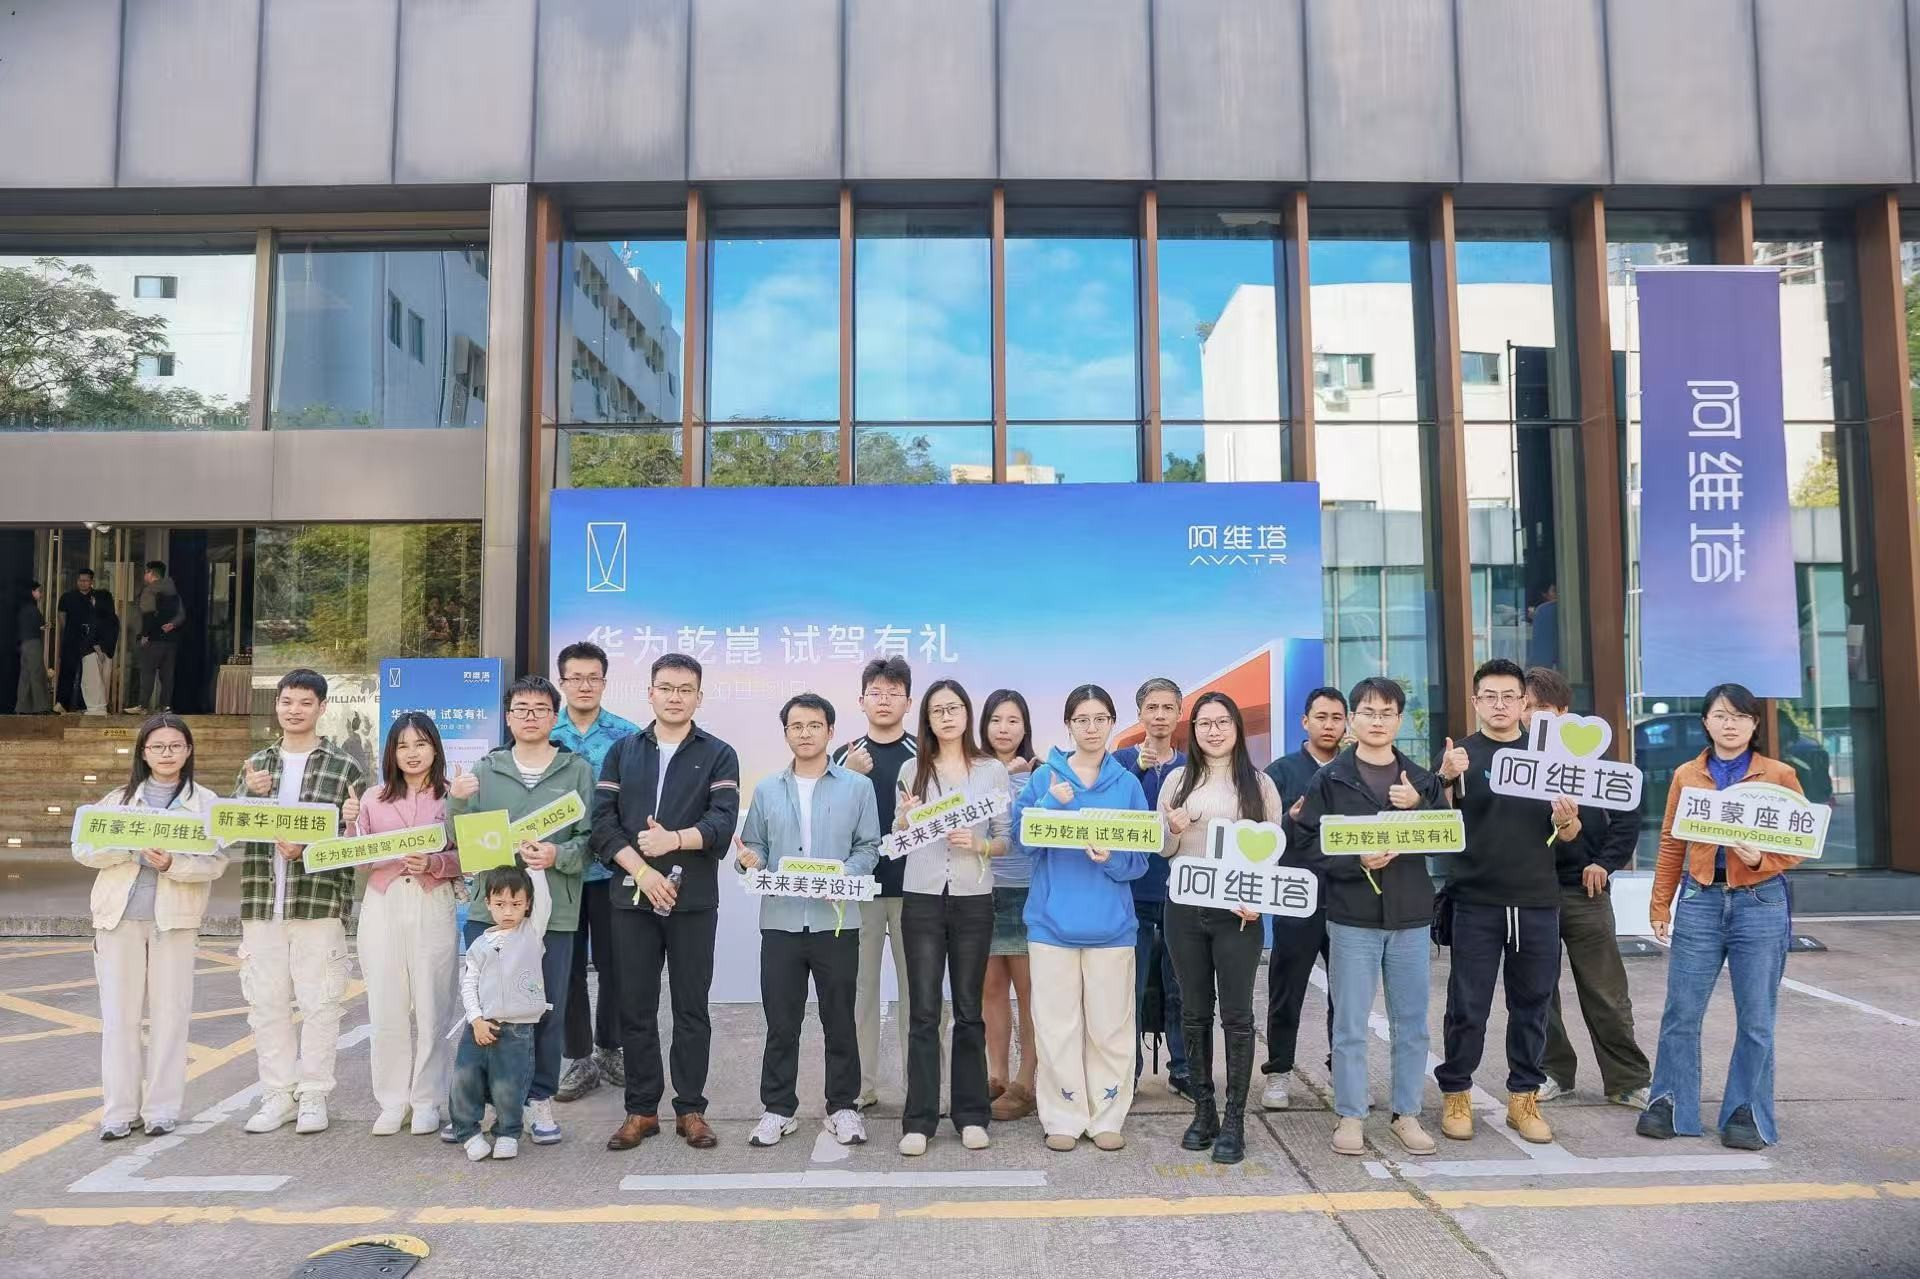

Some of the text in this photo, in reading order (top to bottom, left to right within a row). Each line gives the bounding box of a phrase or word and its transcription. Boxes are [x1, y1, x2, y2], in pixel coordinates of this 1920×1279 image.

[1687, 381, 1746, 582] 阿维塔
[1188, 525, 1287, 549] 阿维塔
[1189, 554, 1287, 565] AVATR
[780, 623, 959, 664] 试驾有礼
[1537, 719, 1548, 751] I
[1498, 756, 1634, 803] 阿维塔
[542, 804, 575, 827] ADS 4
[895, 798, 995, 852] 未来美学设计
[1686, 796, 1815, 834] 鸿蒙座舱
[399, 835, 425, 849] ADS
[428, 833, 436, 843] 4
[1095, 827, 1156, 843] 试驾有礼
[1214, 825, 1225, 859] I
[1396, 828, 1457, 844] 试驾有礼
[1690, 822, 1803, 846] HarmonySpace 5
[786, 863, 837, 872] AVATR
[755, 873, 865, 897] 未来美学设计
[1178, 864, 1309, 909] 阿维塔
